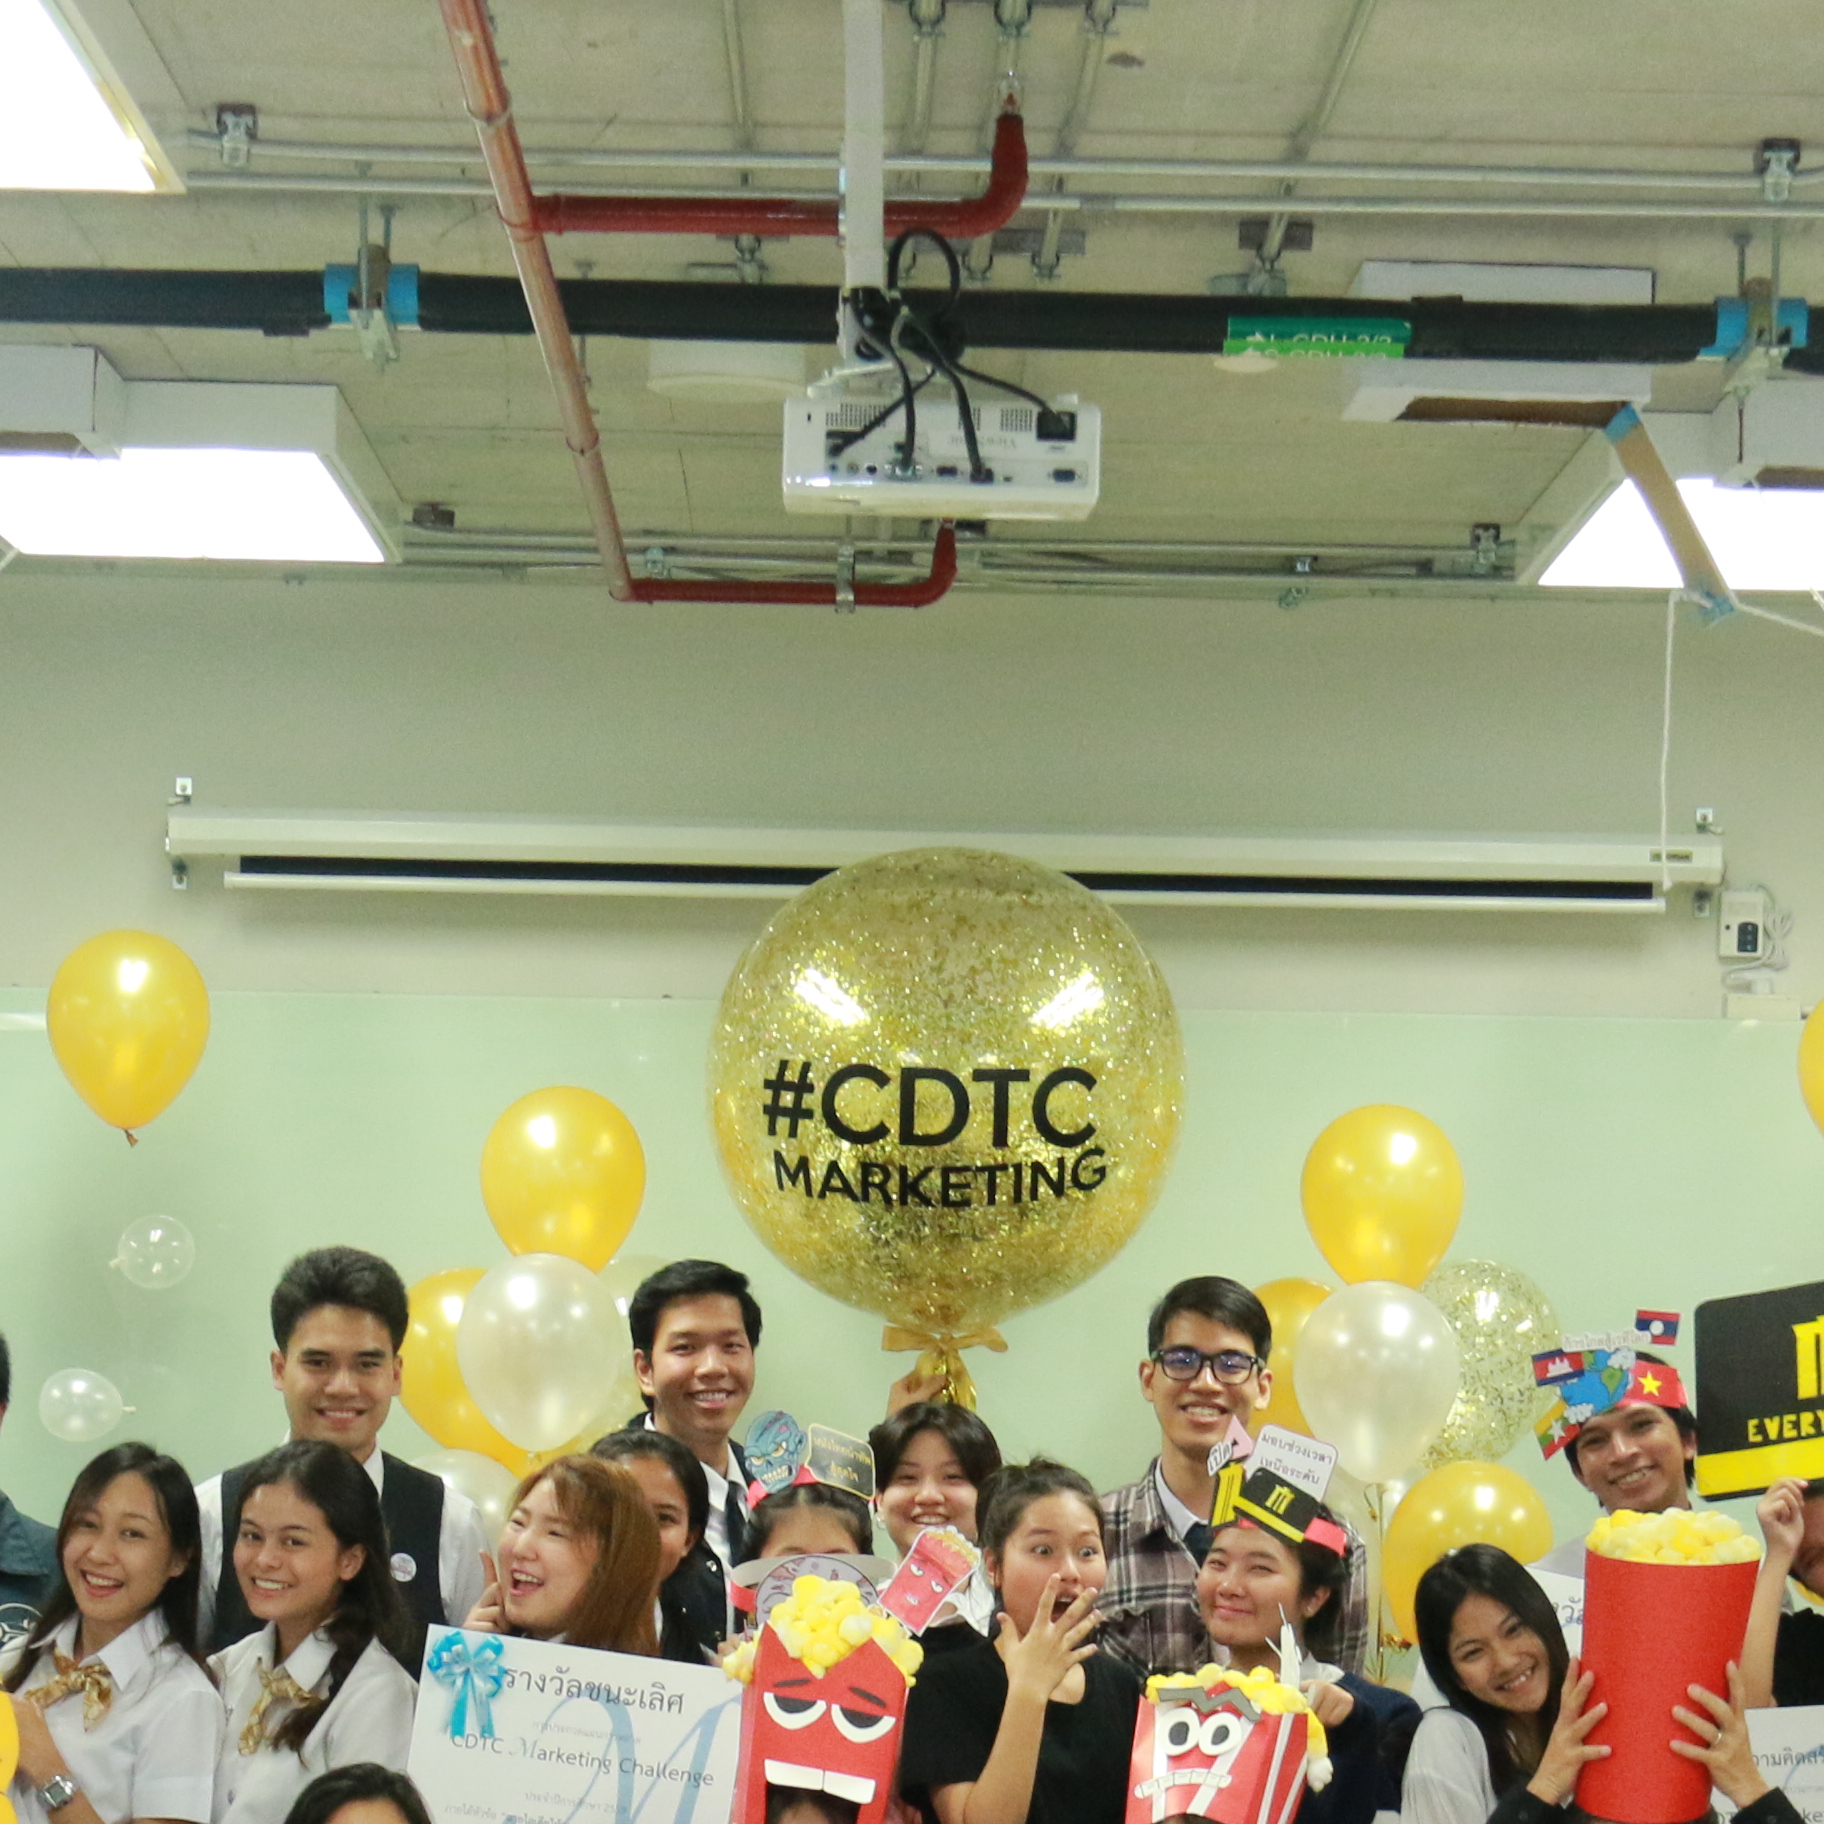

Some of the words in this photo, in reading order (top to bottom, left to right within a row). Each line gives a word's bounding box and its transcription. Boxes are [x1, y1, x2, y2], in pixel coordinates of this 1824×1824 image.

[763, 1059, 1098, 1148] #CDTC
[773, 1148, 1107, 1209] MARKETING
[1259, 1456, 1321, 1485] เหนือระดับ
[1261, 1433, 1333, 1466] มอบช่วงเวลา
[503, 1665, 684, 1715] รางวัลชนะเลิศ
[451, 1733, 504, 1755] CDTC
[508, 1736, 612, 1775] Marketing
[619, 1757, 715, 1788] Challenge
